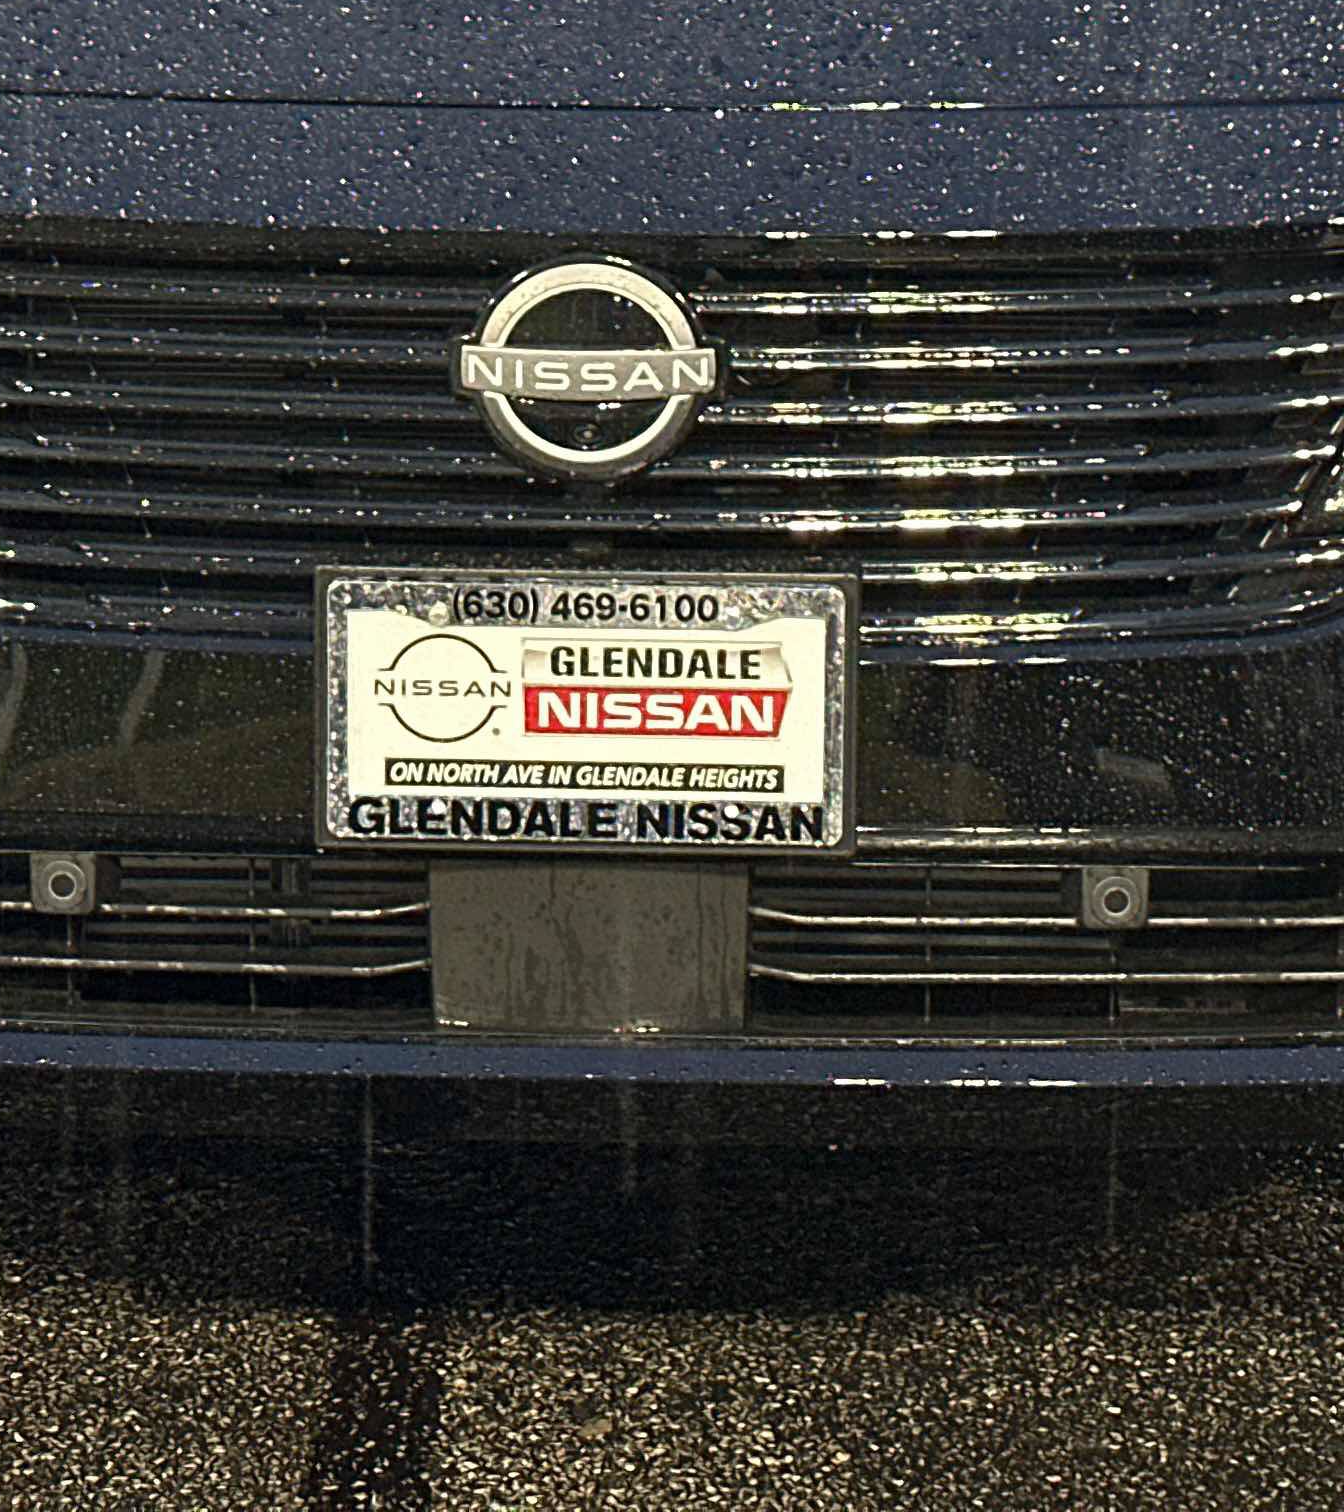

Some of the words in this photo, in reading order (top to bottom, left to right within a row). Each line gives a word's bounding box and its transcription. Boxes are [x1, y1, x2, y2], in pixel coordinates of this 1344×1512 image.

[467, 354, 708, 392] NISSAN
[453, 587, 539, 624] (630)
[550, 591, 719, 623] 469-6100
[549, 645, 761, 680] GLENDALE
[374, 678, 512, 698] NISSAN
[537, 691, 775, 732] NISSAN
[390, 761, 425, 783] ON
[426, 762, 501, 784] NORTH
[503, 764, 545, 785] AVE
[548, 765, 573, 786] IN
[576, 765, 685, 788] GLENDALE
[689, 768, 779, 790] HEIGHTS
[349, 796, 619, 838] GLENDALE
[636, 802, 824, 841] NISSAN
